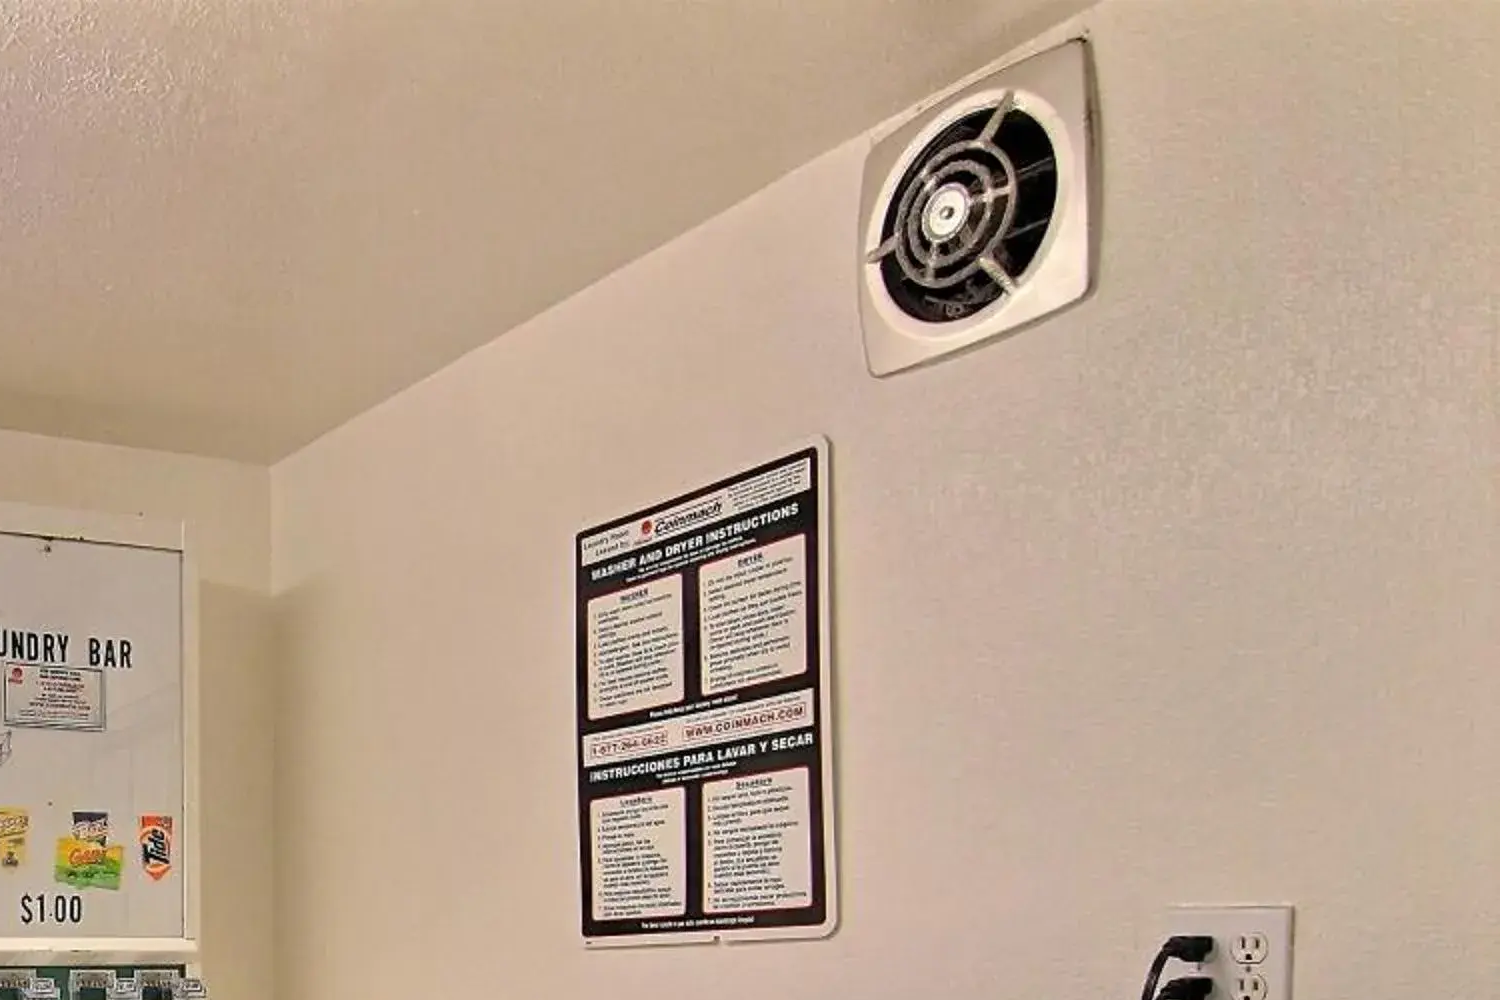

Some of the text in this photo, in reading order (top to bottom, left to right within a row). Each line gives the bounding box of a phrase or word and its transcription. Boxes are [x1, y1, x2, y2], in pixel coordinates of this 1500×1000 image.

[591, 557, 637, 581] WASHER
[639, 549, 663, 565] AND
[665, 535, 703, 558] DRYER
[705, 502, 799, 546] INSTRUCTIONS
[88, 638, 132, 668] BAR
[590, 755, 680, 783] INSTRUCCIONES
[683, 751, 714, 767] PARA
[718, 743, 756, 761] LAVAR
[760, 741, 768, 753] Y
[771, 733, 813, 751] SECAR
[141, 828, 171, 866] Tide
[20, 893, 82, 924] $1.00
